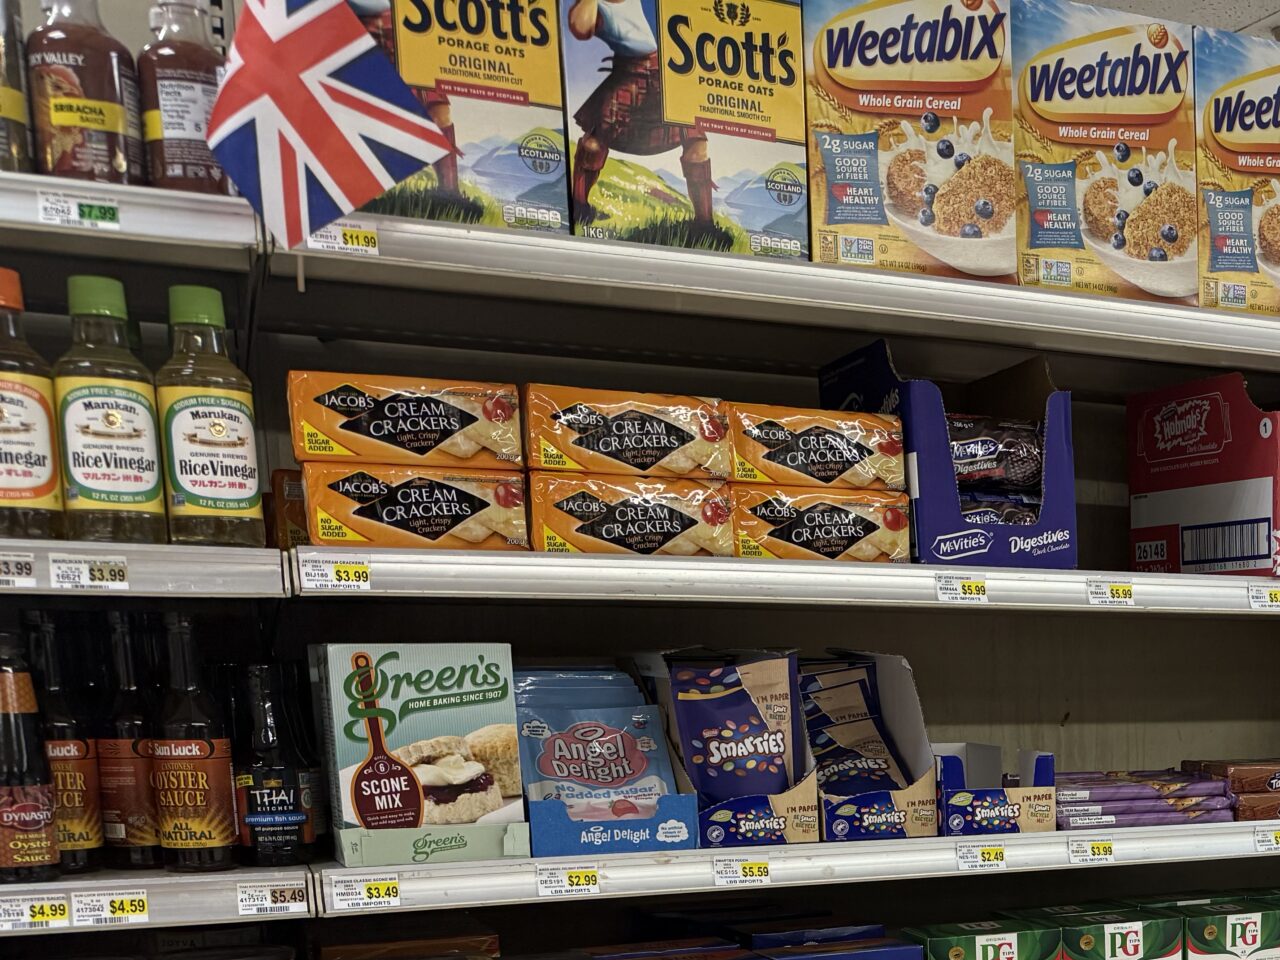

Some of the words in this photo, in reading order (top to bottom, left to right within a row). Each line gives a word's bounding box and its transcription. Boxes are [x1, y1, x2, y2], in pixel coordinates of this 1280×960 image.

[826, 13, 1006, 68] Weetabix
[666, 13, 797, 85] Scott's
[1029, 43, 1189, 101] Weetabix
[698, 76, 743, 93] PORAGE
[746, 83, 775, 97] OATS
[705, 93, 764, 113] ORIGINAL
[858, 94, 891, 109] Whole
[894, 96, 926, 110] Grain
[929, 97, 961, 111] Cereal
[54, 104, 106, 119] SRIRACHA
[823, 135, 841, 154] 2g
[843, 141, 875, 151] SUGAR
[1238, 156, 1264, 168] Whole
[767, 181, 801, 195] SCOTLAND
[846, 187, 873, 197] HEART
[843, 195, 879, 205] HEALTHY
[78, 205, 119, 220] $7.99
[341, 231, 379, 249] $11.99
[324, 394, 374, 409] JACOB'S
[384, 402, 445, 418] CREAM
[370, 417, 459, 436] CRACKERS
[308, 444, 334, 453] ADDED
[804, 514, 853, 526] CREAM
[792, 526, 864, 542] CRACKERS
[1009, 529, 1069, 555] Digestives
[940, 531, 988, 556] McVitie's
[1137, 543, 1166, 559] 26148
[88, 568, 126, 584] $3.99
[335, 569, 368, 584] $3.99
[961, 582, 986, 596] $5.99
[409, 701, 431, 709] HOME
[433, 697, 460, 707] BAKING
[462, 693, 484, 703] SINCE
[485, 690, 502, 700] 1907
[554, 736, 625, 770] Angel
[552, 754, 633, 782] Delight
[156, 771, 209, 790] OYSTER
[361, 776, 410, 795] SCONE
[250, 789, 294, 806] THAI
[375, 793, 403, 810] MIX
[2, 808, 52, 824] DYNASTY
[172, 822, 192, 831] ALL
[161, 829, 216, 842] NATURAL
[981, 850, 1004, 863] $2.49
[1091, 846, 1113, 857] $3.99
[567, 871, 597, 886] $2.99
[742, 865, 769, 878] $5.59
[271, 888, 305, 903] $5.49
[366, 885, 399, 899] $3.49
[29, 902, 66, 918] $4.99
[109, 898, 146, 914] $4.59
[363, 899, 391, 907] IMPORTS
